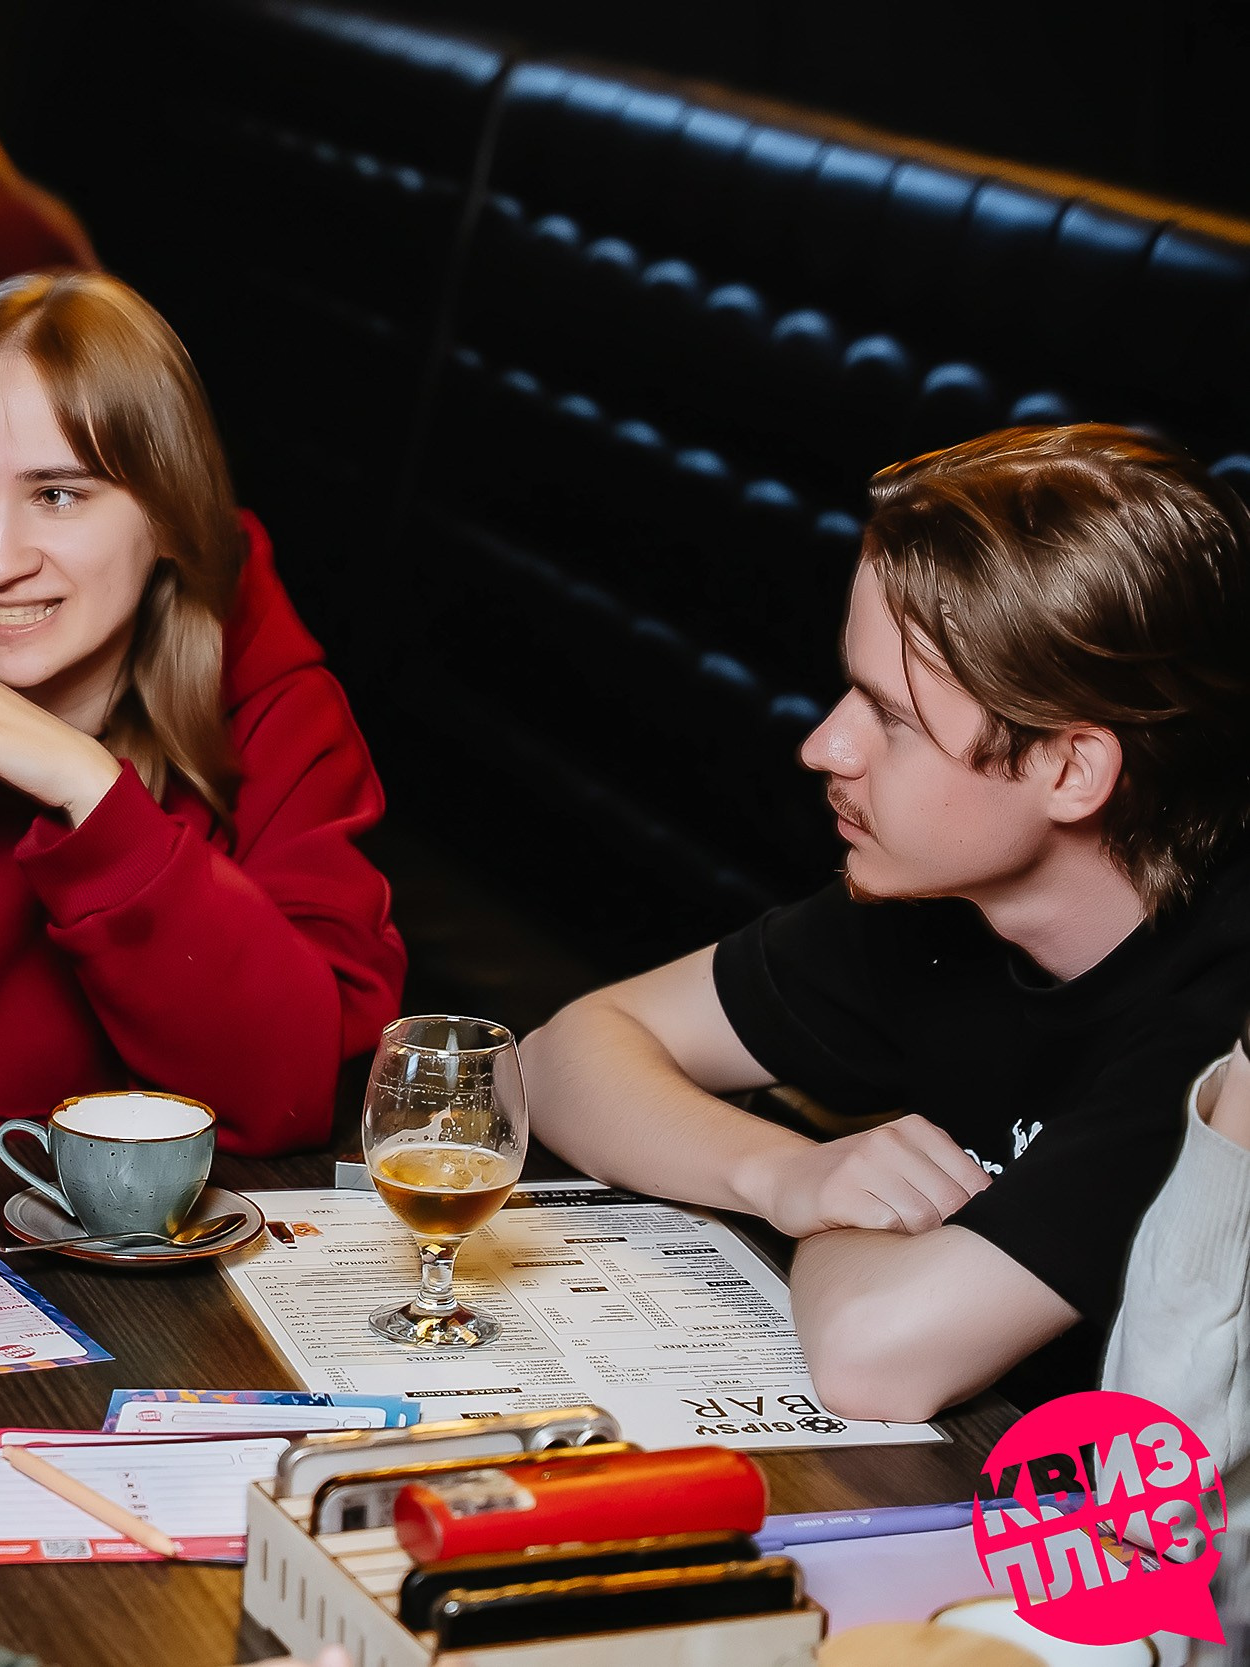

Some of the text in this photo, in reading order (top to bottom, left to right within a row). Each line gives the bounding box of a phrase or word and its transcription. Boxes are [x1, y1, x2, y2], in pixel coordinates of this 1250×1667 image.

[472, 1387, 516, 1395] COGNAC
[679, 1394, 822, 1419] BAR
[694, 1421, 796, 1436] GIPSY
